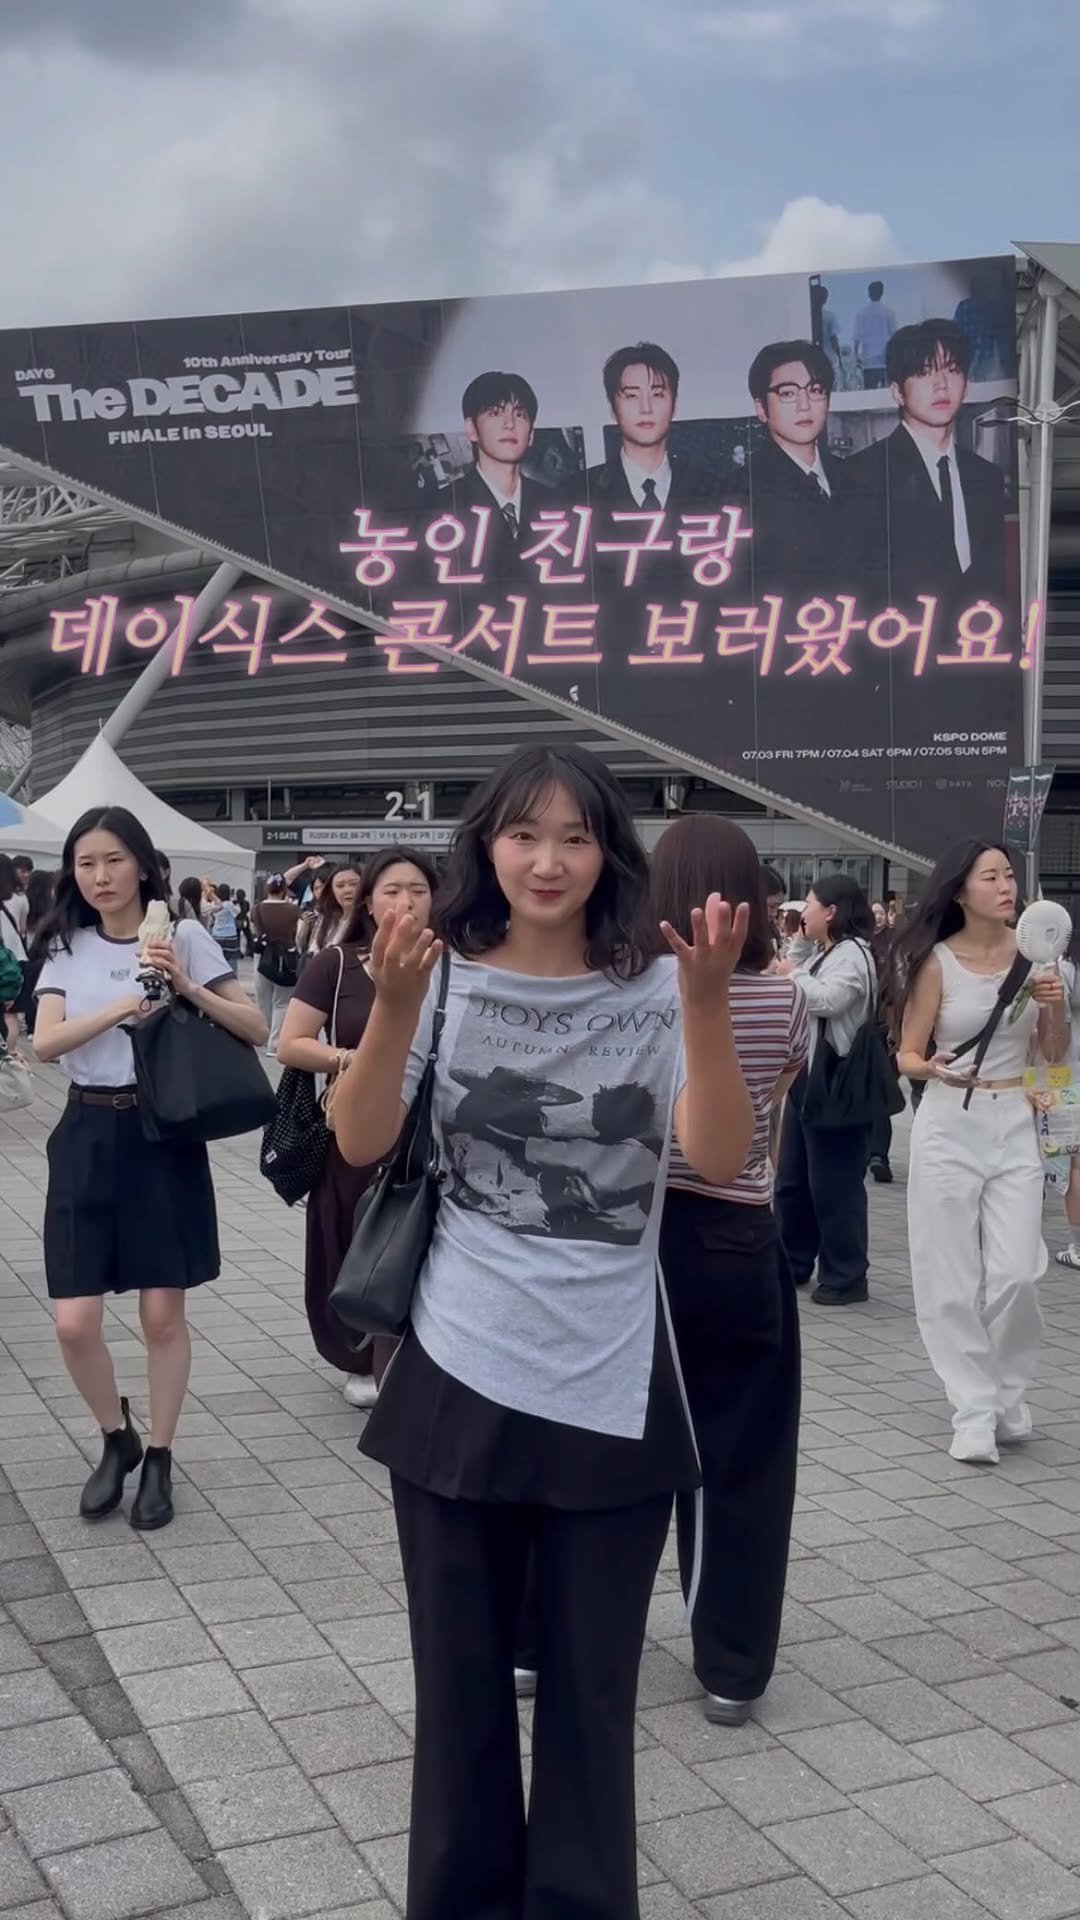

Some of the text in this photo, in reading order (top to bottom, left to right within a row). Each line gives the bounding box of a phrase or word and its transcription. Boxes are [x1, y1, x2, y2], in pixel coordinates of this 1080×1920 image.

[184, 349, 352, 369] 10th Anniversary Tour
[15, 368, 56, 381] DAY6
[17, 365, 360, 422] The DECADE
[107, 428, 180, 445] FINALE
[204, 423, 273, 440] SEOUL
[933, 732, 1008, 742] KSPO DOME
[742, 750, 774, 760] 07.03
[775, 750, 794, 759] FRI
[795, 749, 820, 759] 7PM
[827, 748, 860, 758] 07.04
[861, 748, 884, 758] SAT
[886, 748, 912, 757] 6PM
[954, 746, 980, 755] SUN
[384, 791, 431, 821] 2-1
[587, 1006, 680, 1033] OWN
[482, 1034, 661, 1057] AUTUMN REVIEW
